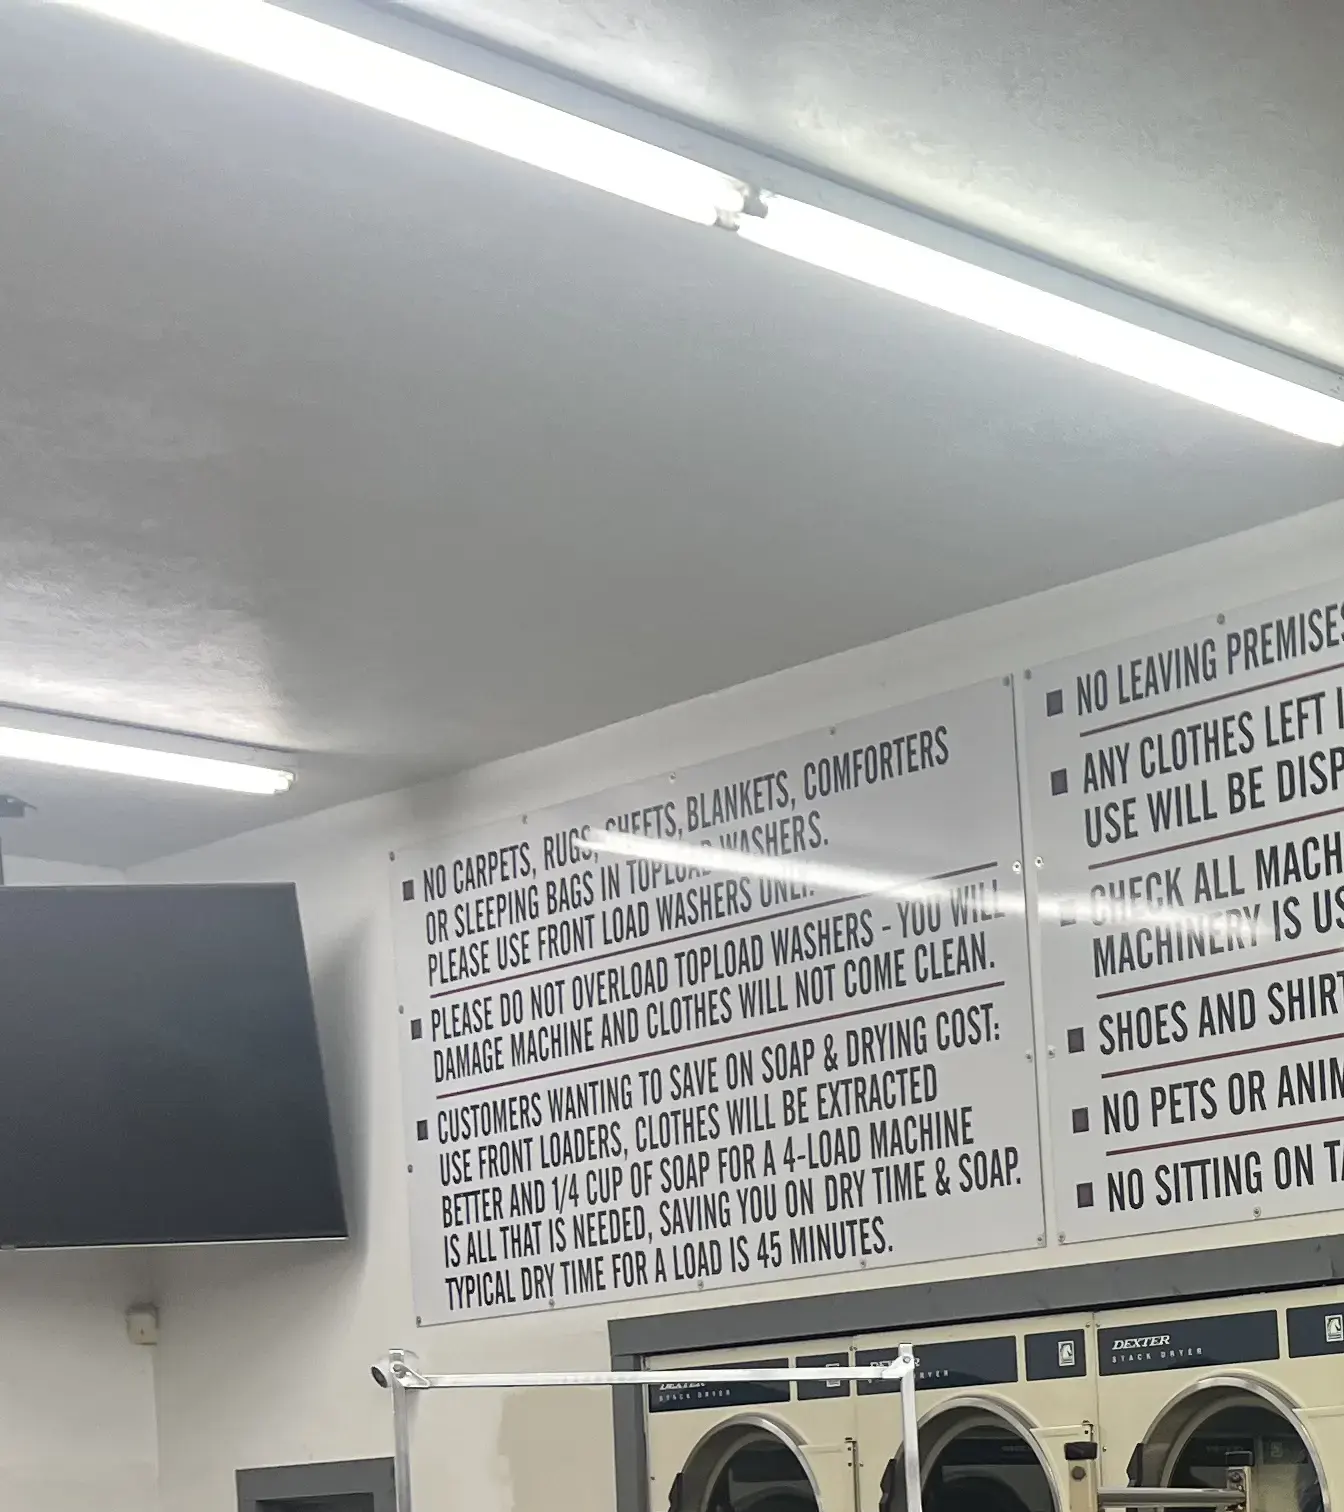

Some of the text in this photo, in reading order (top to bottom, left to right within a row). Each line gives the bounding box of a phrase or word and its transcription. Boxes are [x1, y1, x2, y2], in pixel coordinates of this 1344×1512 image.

[1077, 670, 1108, 716] NO
[1118, 639, 1216, 704] LEAVING
[1084, 742, 1129, 794] ANY
[1140, 711, 1254, 779] CLOTHES
[1265, 691, 1325, 748] LEFT
[1085, 797, 1138, 848] USE
[1147, 779, 1217, 833] WILL
[1228, 765, 1265, 815] BE
[1195, 855, 1245, 904] ALL
[1093, 904, 1260, 978] MACHINERY
[1273, 896, 1301, 942] IS
[1099, 1000, 1188, 1055] SHOES
[1199, 988, 1256, 1038] AND
[438, 1002, 999, 1144] CUSTOMERS WANTING TO SAVE ON SOAP & DRYING COST:
[1103, 1090, 1139, 1135] NO
[1151, 1077, 1217, 1127] PETS
[1228, 1070, 1266, 1115] OR
[1108, 1168, 1144, 1212] NO
[1155, 1151, 1262, 1206] SITTING
[1274, 1144, 1313, 1190] ON
[445, 1216, 893, 1310] TYPICAL DRY TIME FOR A LOAD IS 45 MINUTES.
[1111, 1334, 1170, 1351] DEXTER
[1111, 1350, 1153, 1364] STACK
